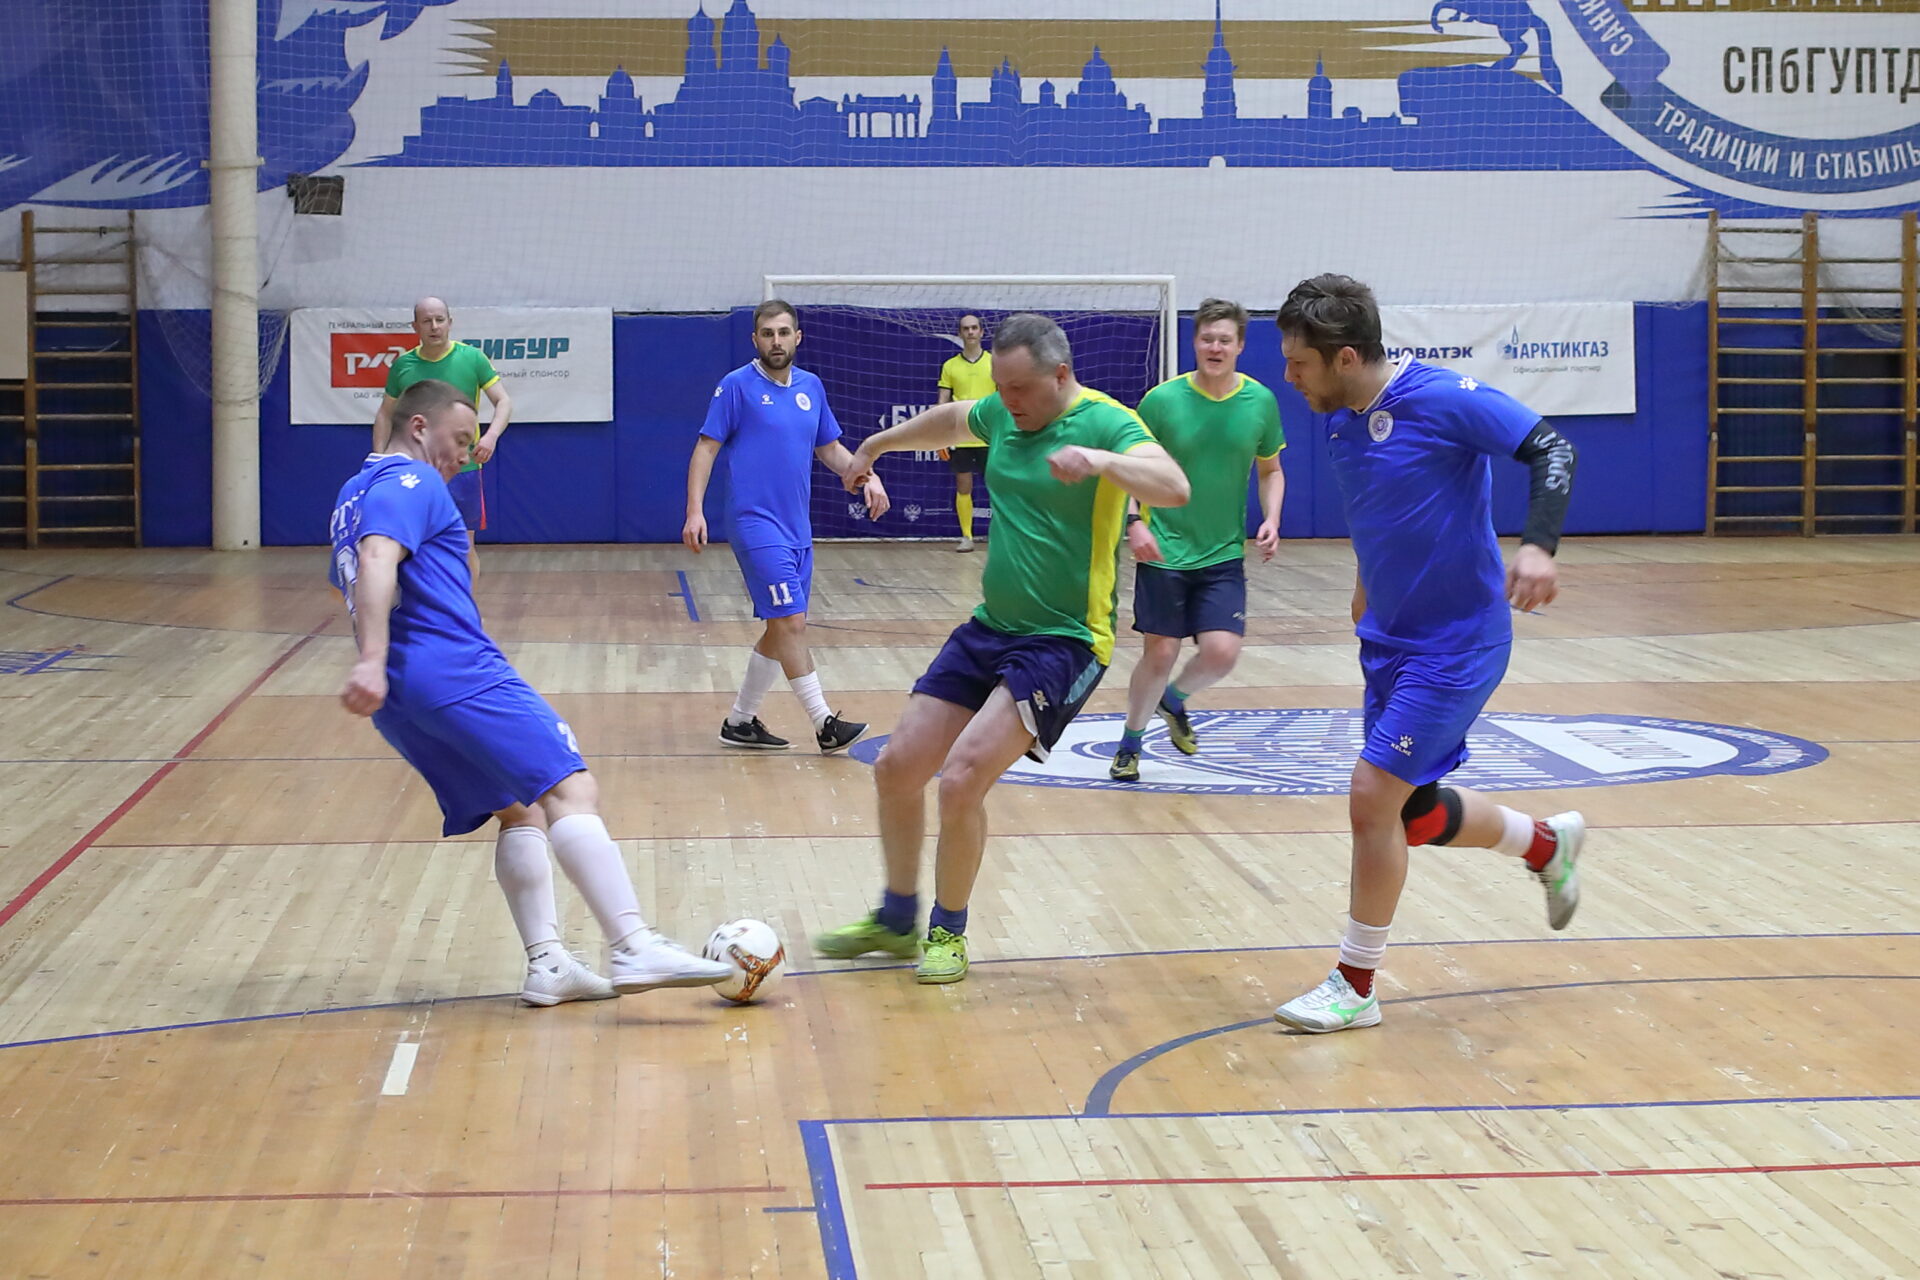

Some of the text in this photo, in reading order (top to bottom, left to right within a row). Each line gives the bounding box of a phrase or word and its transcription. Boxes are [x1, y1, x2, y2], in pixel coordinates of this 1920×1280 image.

[1574, 0, 1634, 57] САНК
[1722, 45, 1920, 103] СПбГУПТД
[1653, 101, 1920, 180] ТРАДИЦИИ И СТАБИЛЬ
[328, 321, 414, 329] ГЕНЕРАЛЬНЫЙ СПОНС
[1387, 346, 1473, 359] НОВАТЭК
[1520, 340, 1609, 359] АРКТИКГАЗ
[530, 369, 570, 379] спонсор
[768, 582, 793, 606] 11
